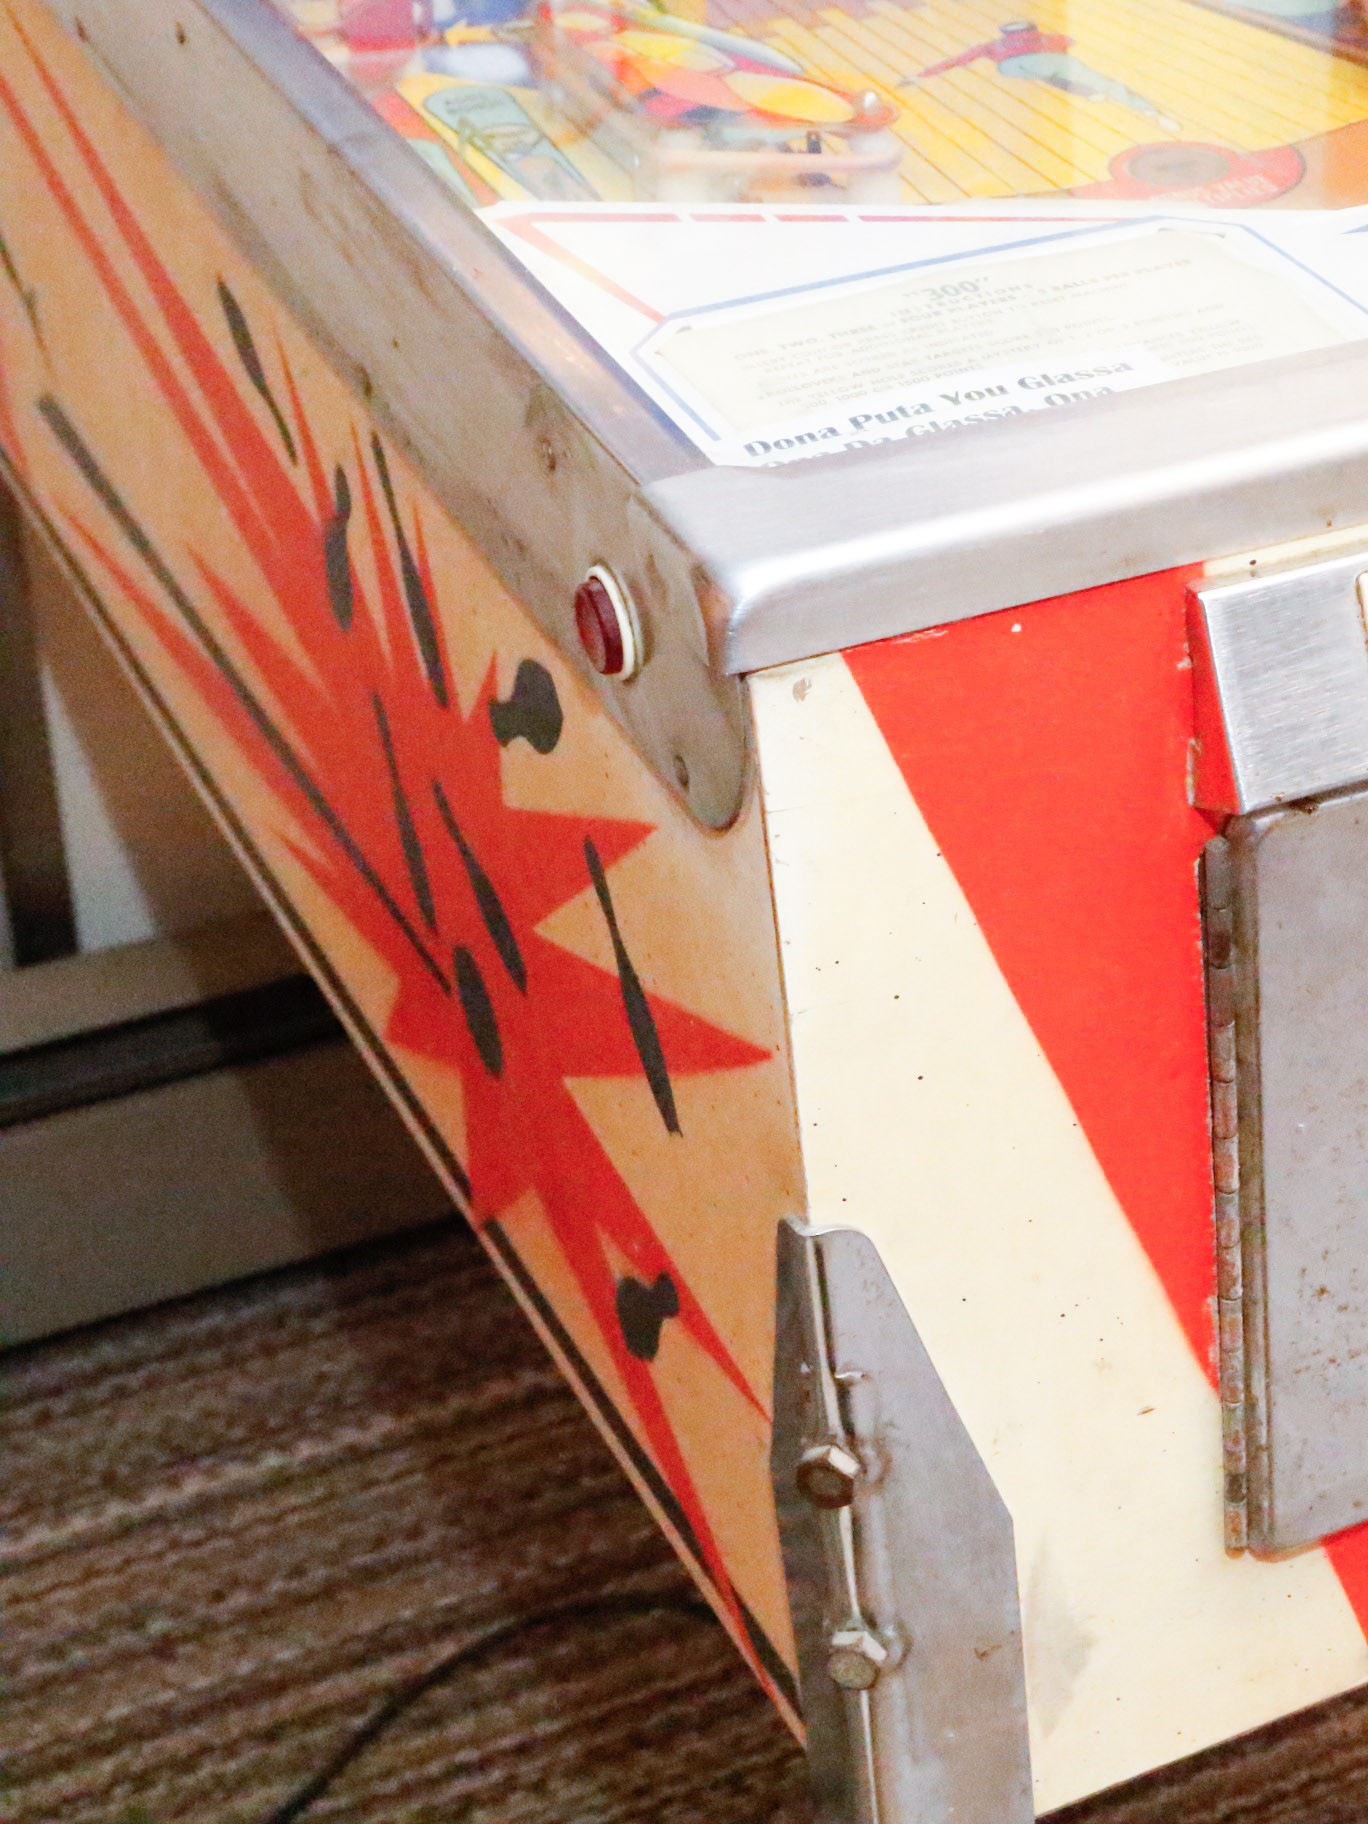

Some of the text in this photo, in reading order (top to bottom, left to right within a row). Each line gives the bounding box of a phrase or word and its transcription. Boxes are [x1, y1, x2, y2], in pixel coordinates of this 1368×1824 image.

[743, 362, 1135, 457] Dona Puta You Glassa
